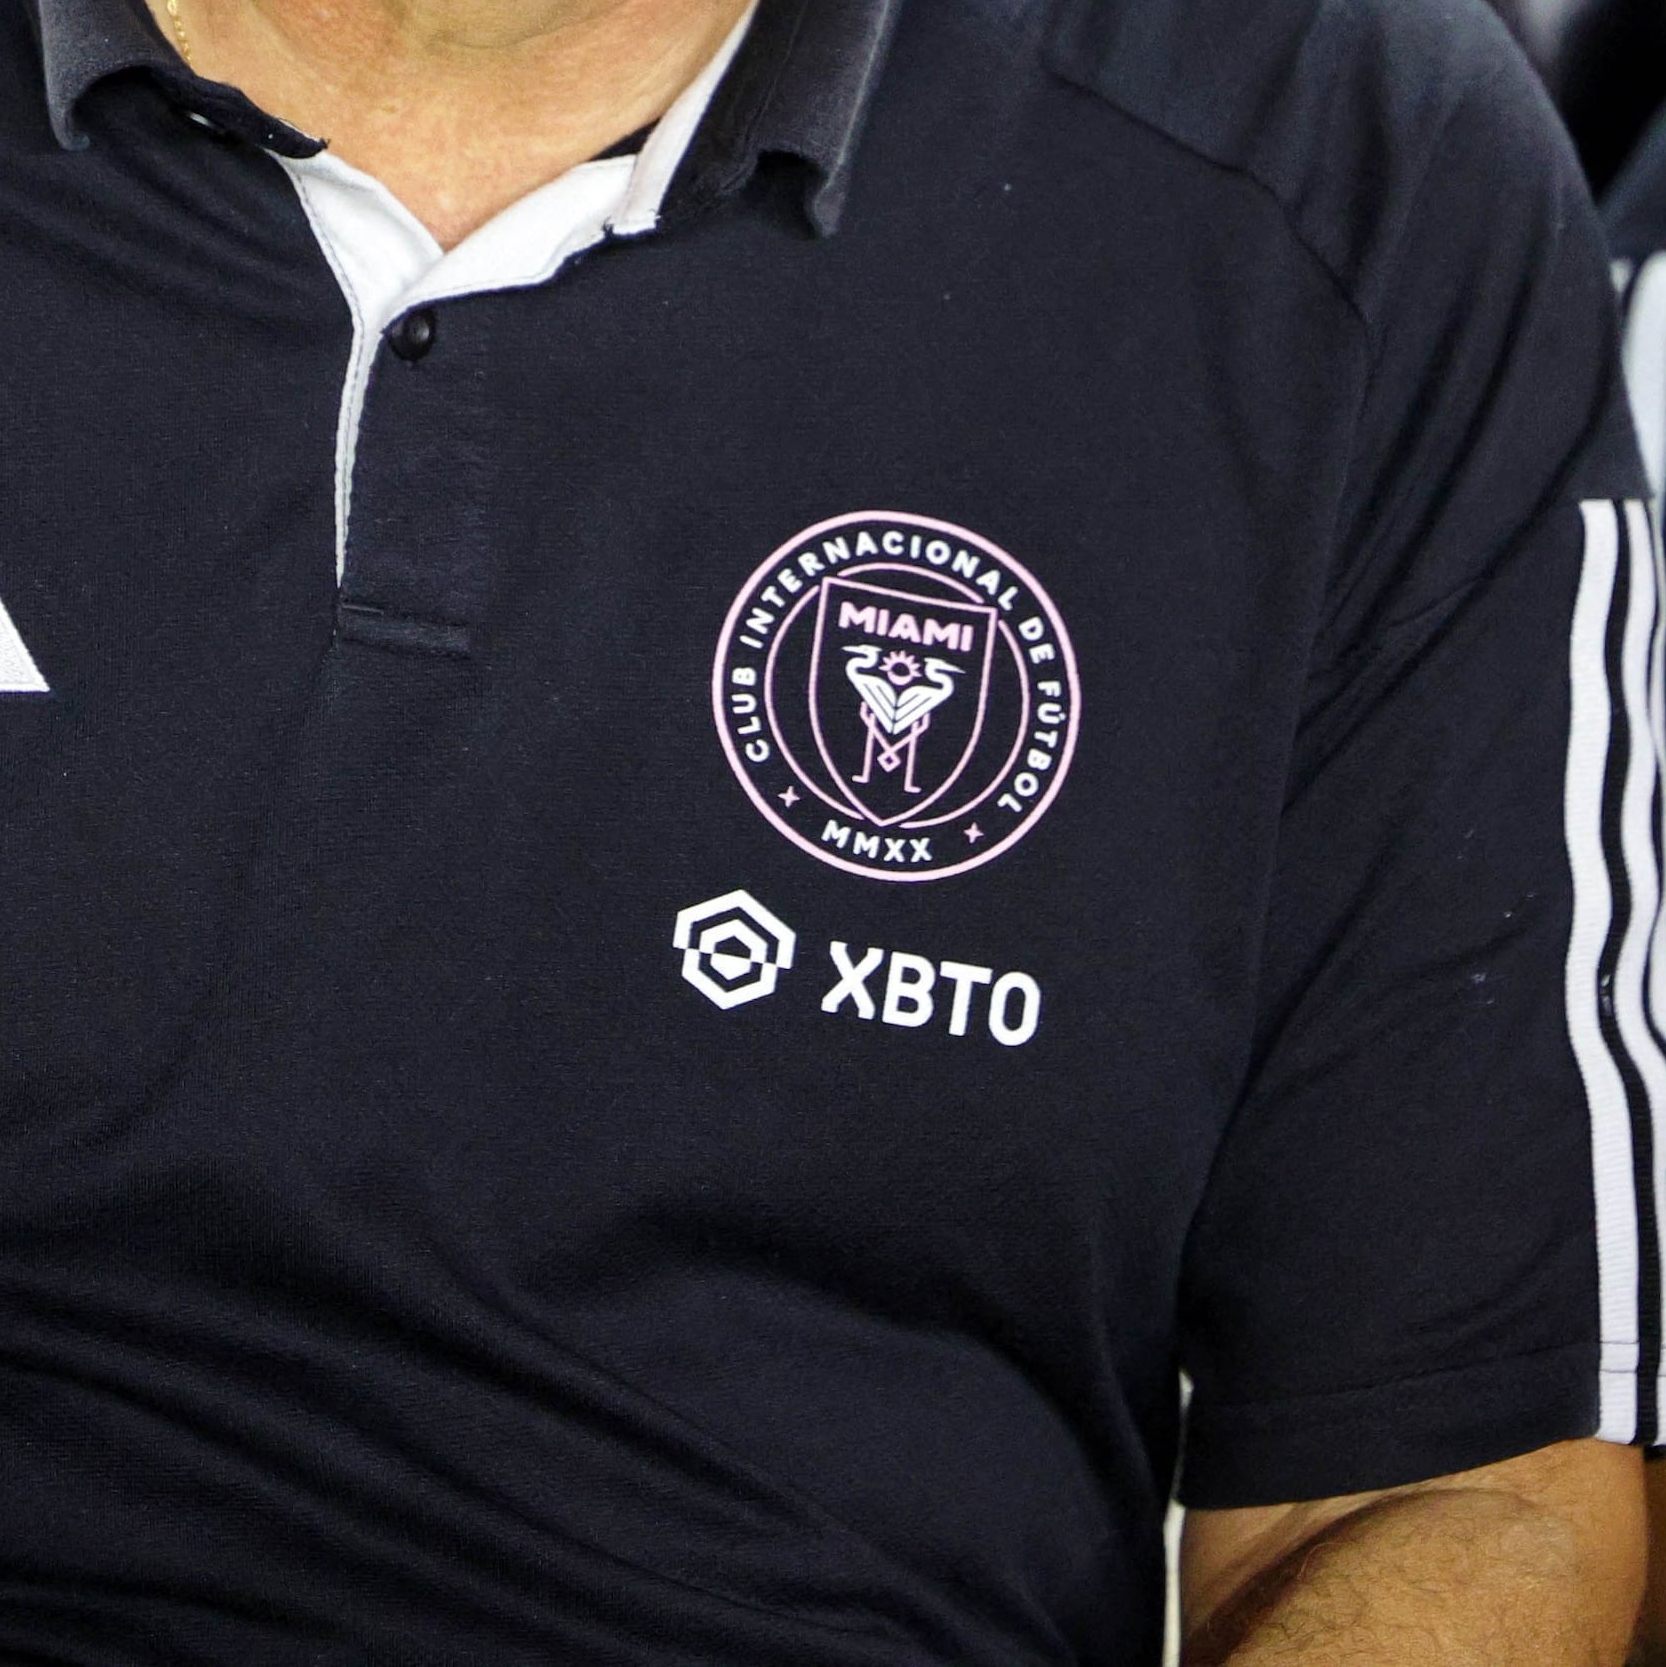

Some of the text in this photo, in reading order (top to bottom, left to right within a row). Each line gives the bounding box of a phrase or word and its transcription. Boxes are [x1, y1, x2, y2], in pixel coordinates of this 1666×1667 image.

[838, 600, 975, 653] MIAMI
[731, 530, 1068, 814] CLUB INTERNACIONAL DE FÚTBOL
[819, 818, 934, 864] MMXX
[820, 940, 1042, 1047] XBTO
